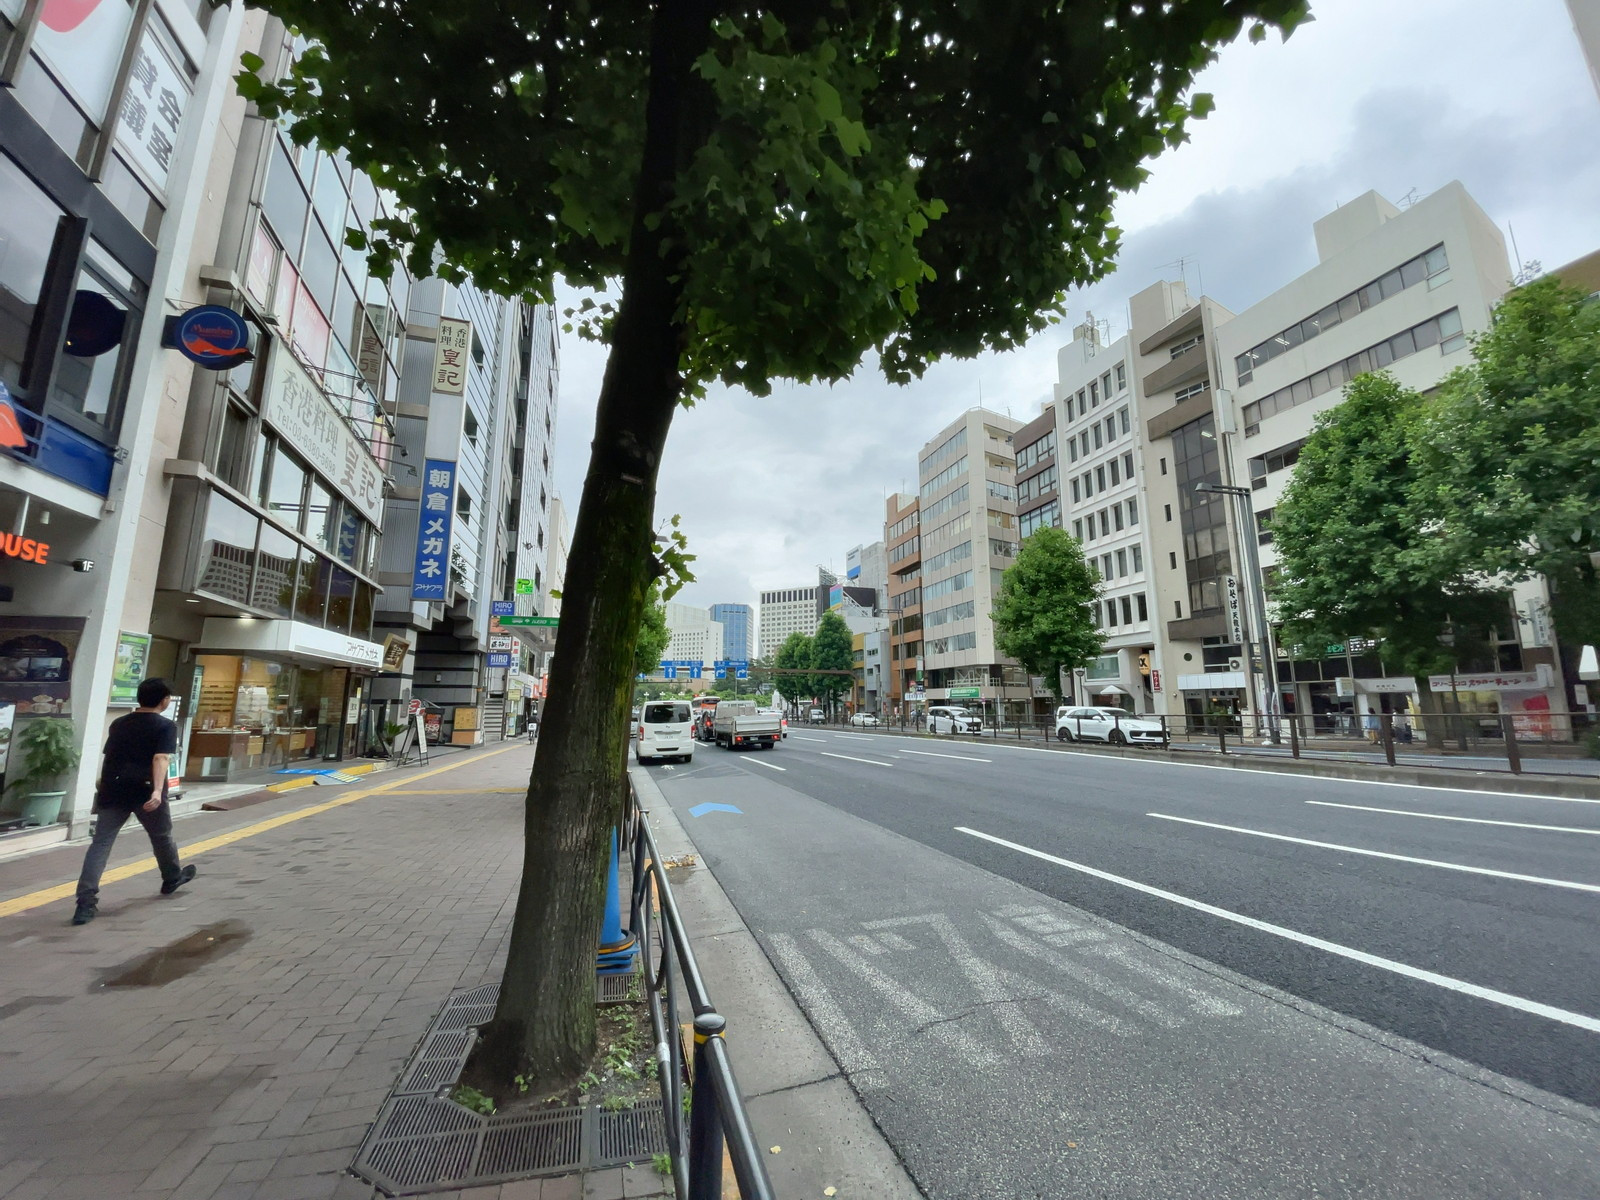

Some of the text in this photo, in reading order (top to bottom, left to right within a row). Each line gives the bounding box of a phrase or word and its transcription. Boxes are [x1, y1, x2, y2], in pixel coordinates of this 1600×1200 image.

[440, 325, 452, 345] 料理
[455, 328, 467, 349] 香港
[437, 349, 461, 386] 皇記
[281, 369, 339, 457] 香港料理
[340, 437, 376, 510] 皇記
[419, 468, 450, 578] 朝倉メガネ
[414, 583, 444, 593] アサクラ
[490, 654, 508, 663] HIRO
